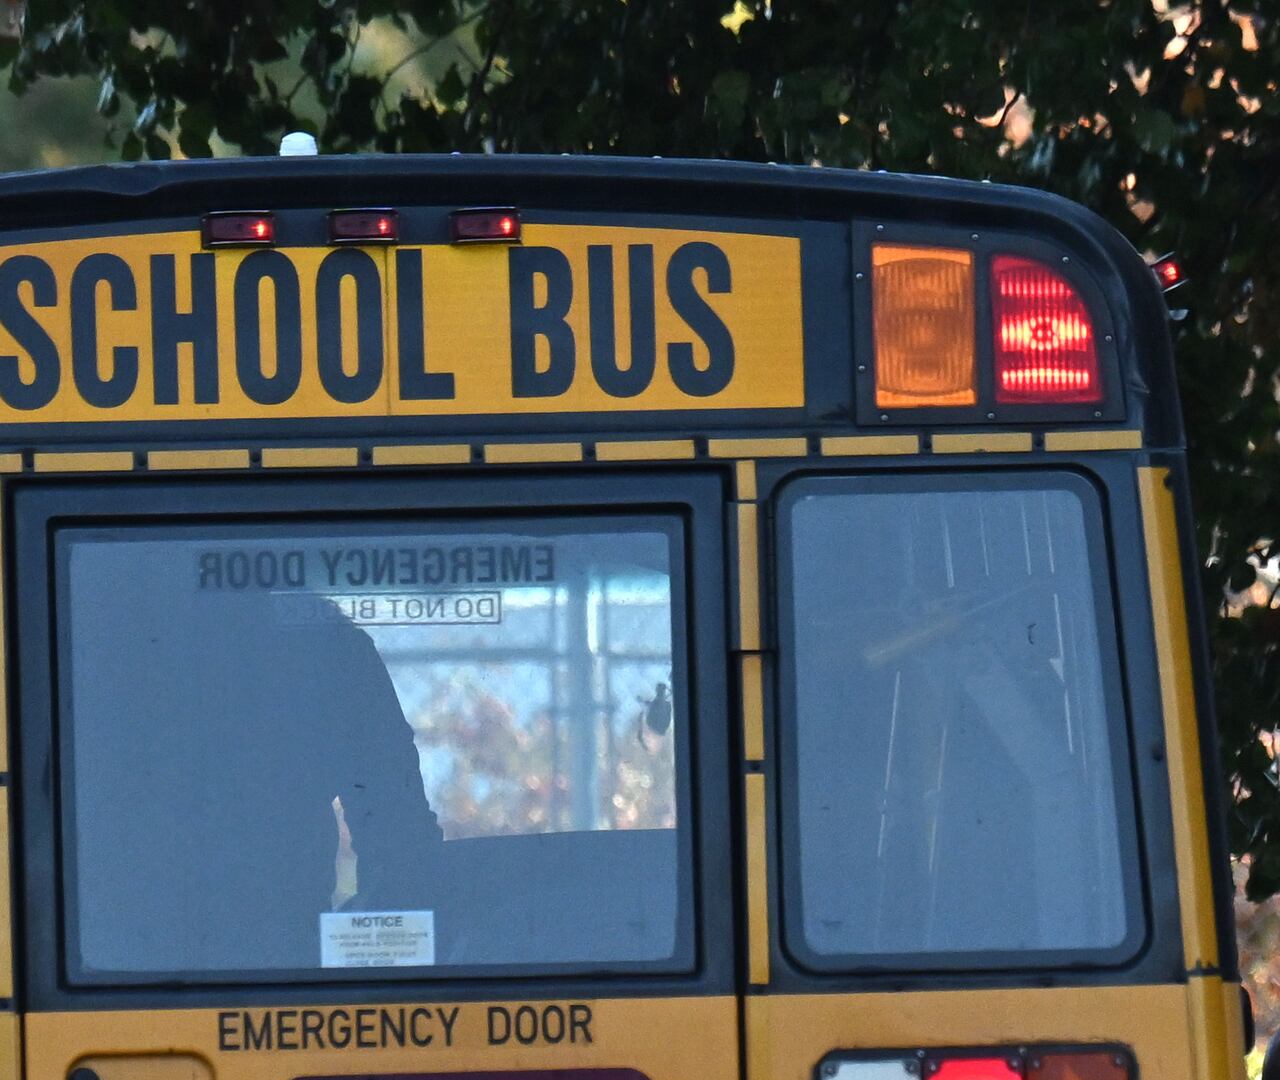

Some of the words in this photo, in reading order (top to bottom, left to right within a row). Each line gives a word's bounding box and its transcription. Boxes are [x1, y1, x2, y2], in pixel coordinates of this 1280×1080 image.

[508, 241, 736, 400] BUS
[351, 916, 403, 928] NOTICE
[219, 1007, 460, 1051] EMERGENCY
[487, 1004, 594, 1046] DOOR
